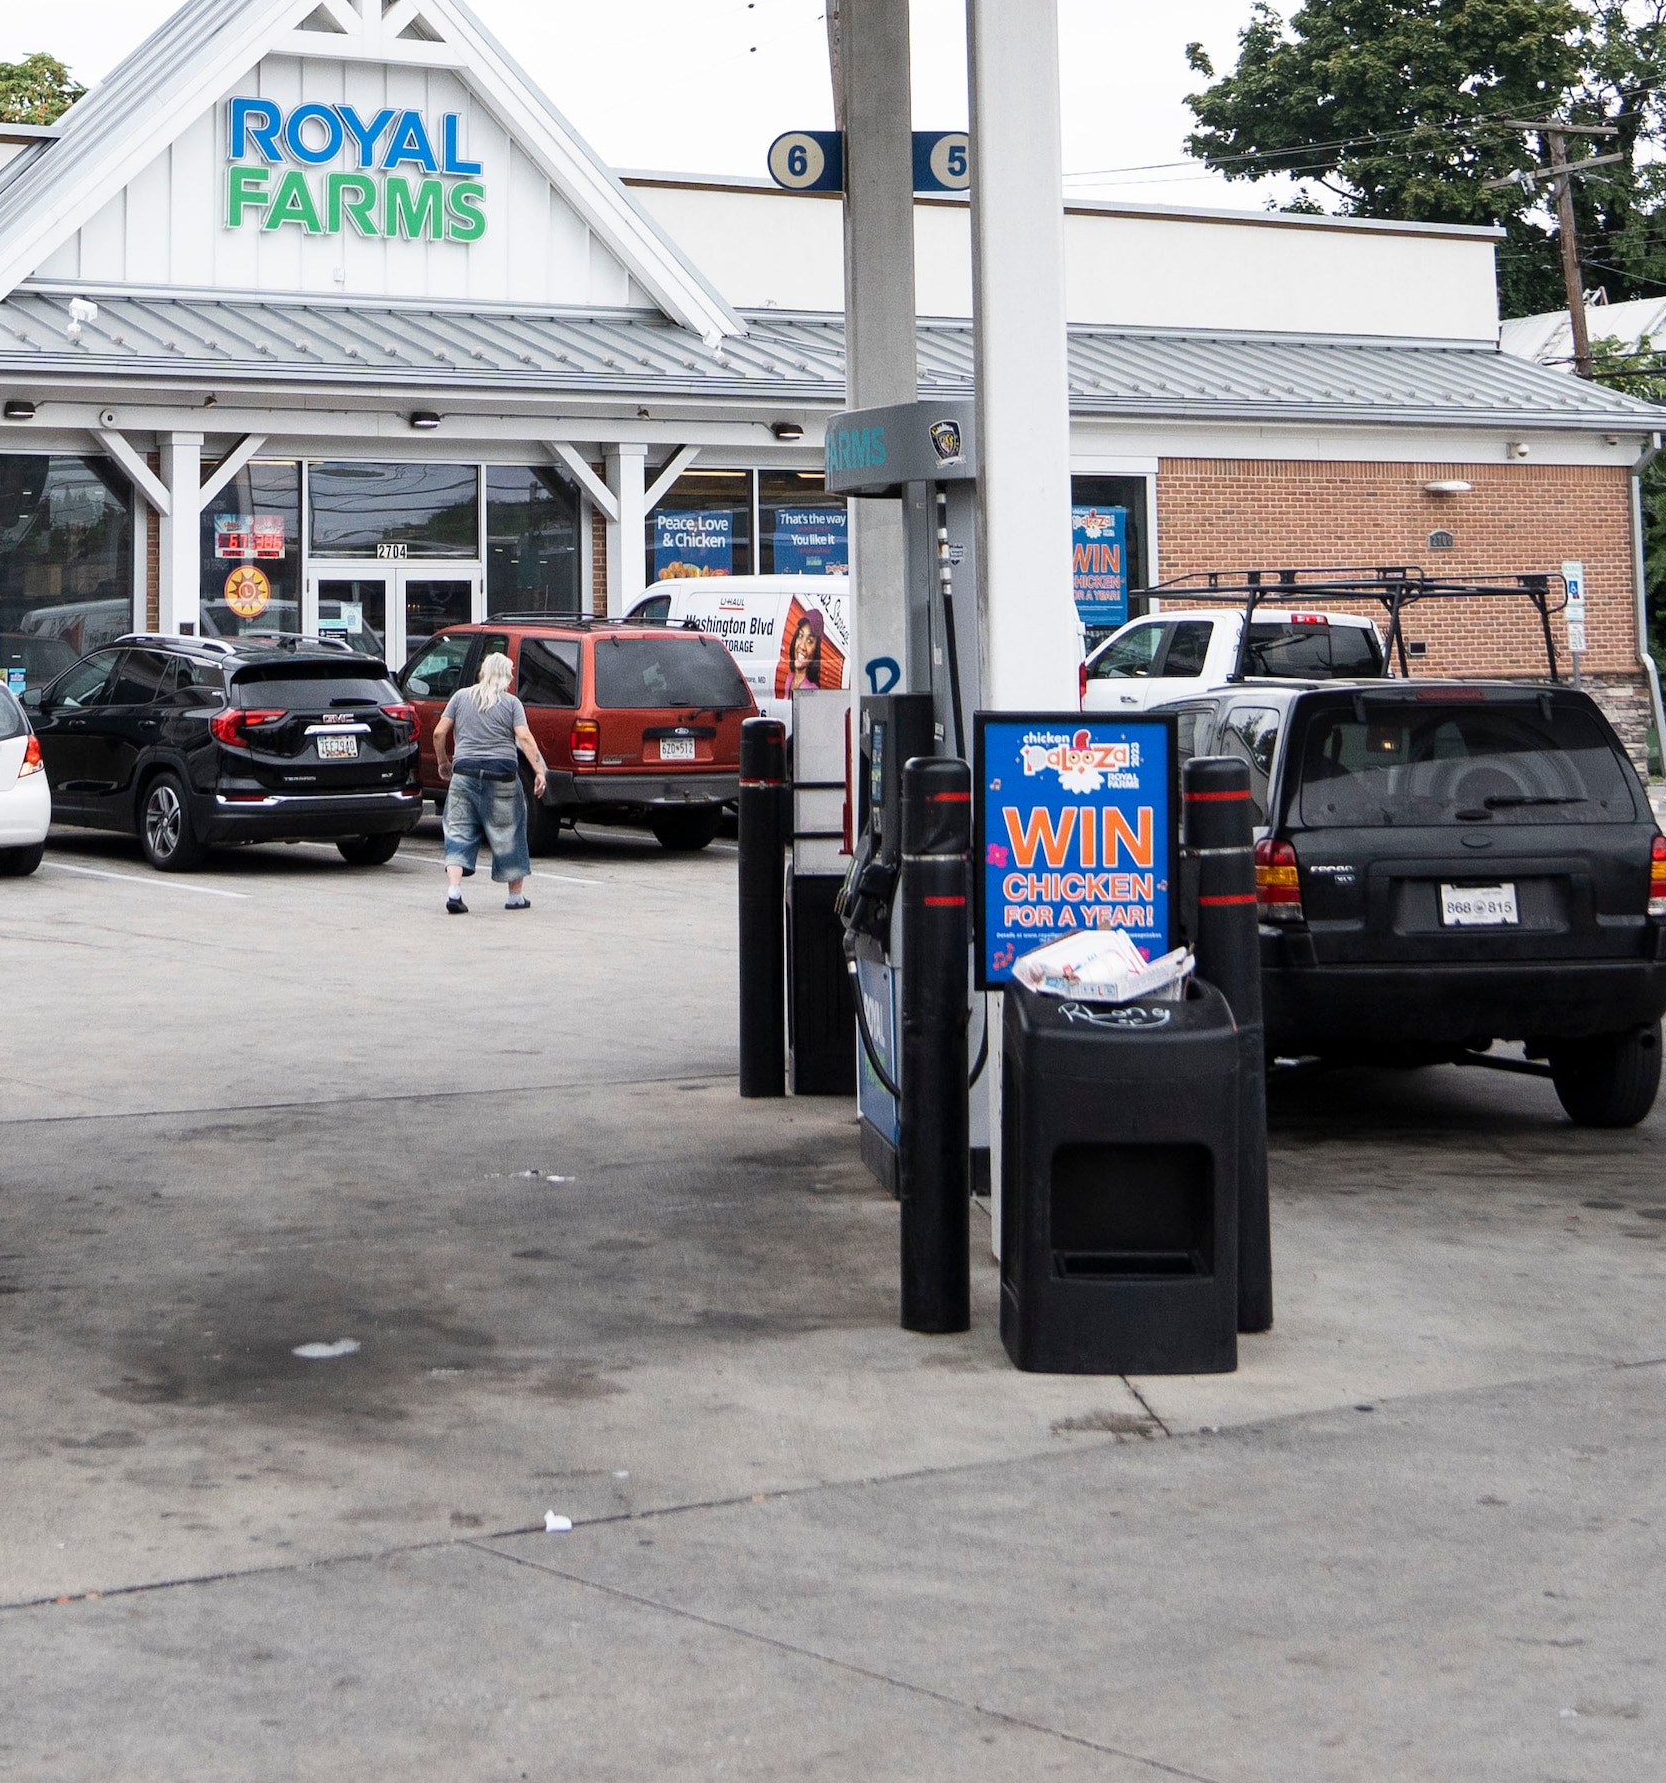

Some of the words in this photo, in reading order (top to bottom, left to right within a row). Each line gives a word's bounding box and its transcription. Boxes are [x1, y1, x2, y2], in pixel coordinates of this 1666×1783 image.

[227, 96, 483, 176] ROYAL
[787, 145, 808, 177] 6
[947, 145, 967, 177] 5
[224, 165, 488, 243] FARMS
[826, 426, 886, 473] ARMS
[699, 516, 729, 532] Love
[780, 513, 809, 525] That's
[809, 513, 826, 525] the
[826, 515, 847, 527] way
[663, 532, 674, 547] &
[675, 532, 726, 548] Chicken
[791, 534, 809, 546] You
[810, 533, 827, 545] like
[828, 533, 836, 545] it
[378, 544, 407, 558] 2704
[1074, 575, 1120, 589] HICKEN
[686, 614, 746, 637] Washington
[750, 617, 774, 636] Blvd
[322, 714, 354, 723] GMC
[1023, 731, 1070, 744] chicken
[1131, 742, 1141, 767] 2023
[1107, 773, 1137, 782] ROYAL
[1107, 780, 1140, 789] FARMS
[1002, 806, 1154, 869] WIN
[1003, 873, 1154, 902] CHICKEN
[1447, 901, 1471, 914] 868
[1488, 901, 1512, 913] 815
[1004, 905, 1054, 927] FOR
[1058, 905, 1077, 927] A
[1081, 905, 1154, 927] YEAR!
